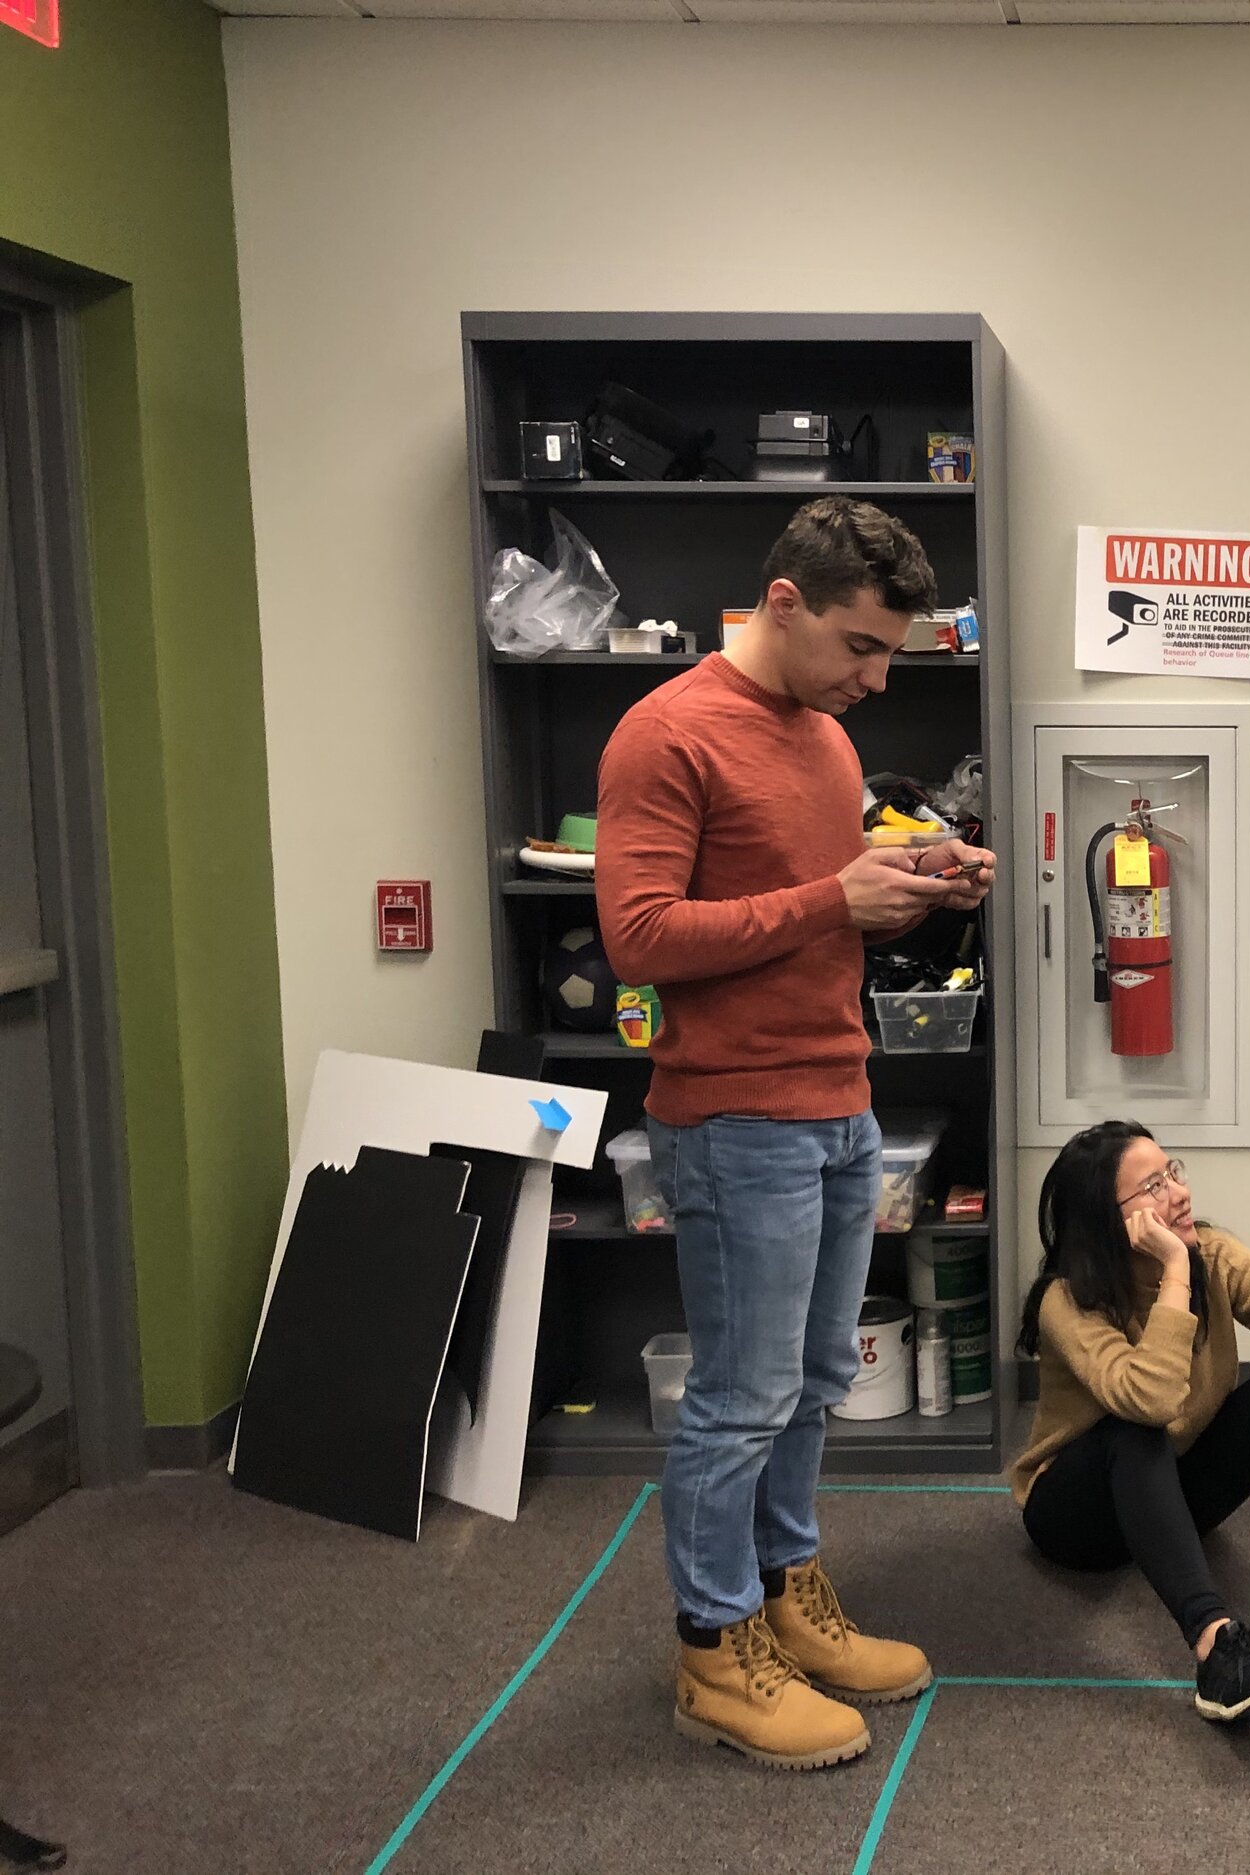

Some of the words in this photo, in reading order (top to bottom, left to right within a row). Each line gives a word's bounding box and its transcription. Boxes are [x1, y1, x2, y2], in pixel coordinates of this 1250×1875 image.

[1166, 593, 1189, 606] ALL
[1163, 608, 1189, 620] ARE
[1164, 623, 1173, 631] TO
[1189, 624, 1196, 632] IN
[1172, 641, 1203, 649] AGAINST
[1163, 649, 1197, 657] Research
[1208, 650, 1234, 658] Queue
[1235, 651, 1250, 659] line
[1163, 658, 1197, 666] behavior
[385, 895, 415, 906] FIRE
